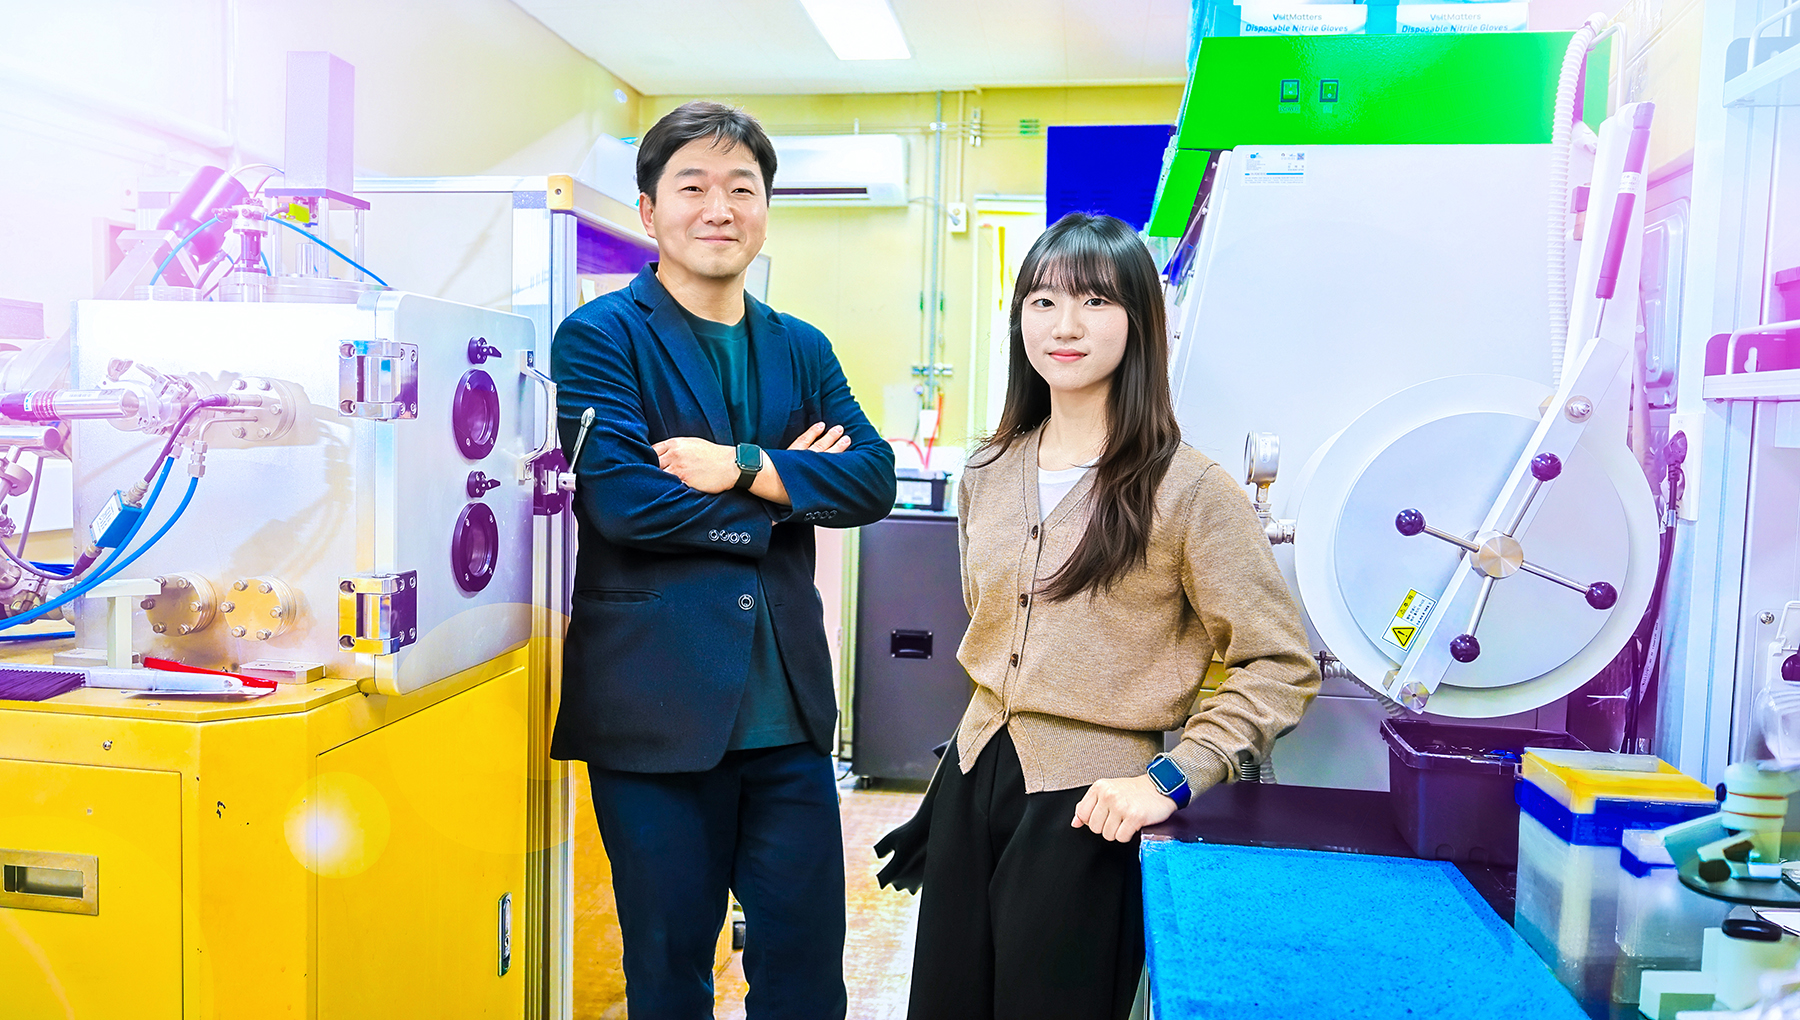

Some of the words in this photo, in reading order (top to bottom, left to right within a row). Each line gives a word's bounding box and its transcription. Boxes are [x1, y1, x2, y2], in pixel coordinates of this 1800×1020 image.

[1245, 23, 1290, 33] Disposable
[1292, 23, 1319, 32] Nitrile
[1321, 23, 1348, 32] Gloves
[1401, 24, 1448, 33] Disposable
[1450, 24, 1478, 32] Nitrile
[1480, 23, 1508, 32] Gloves
